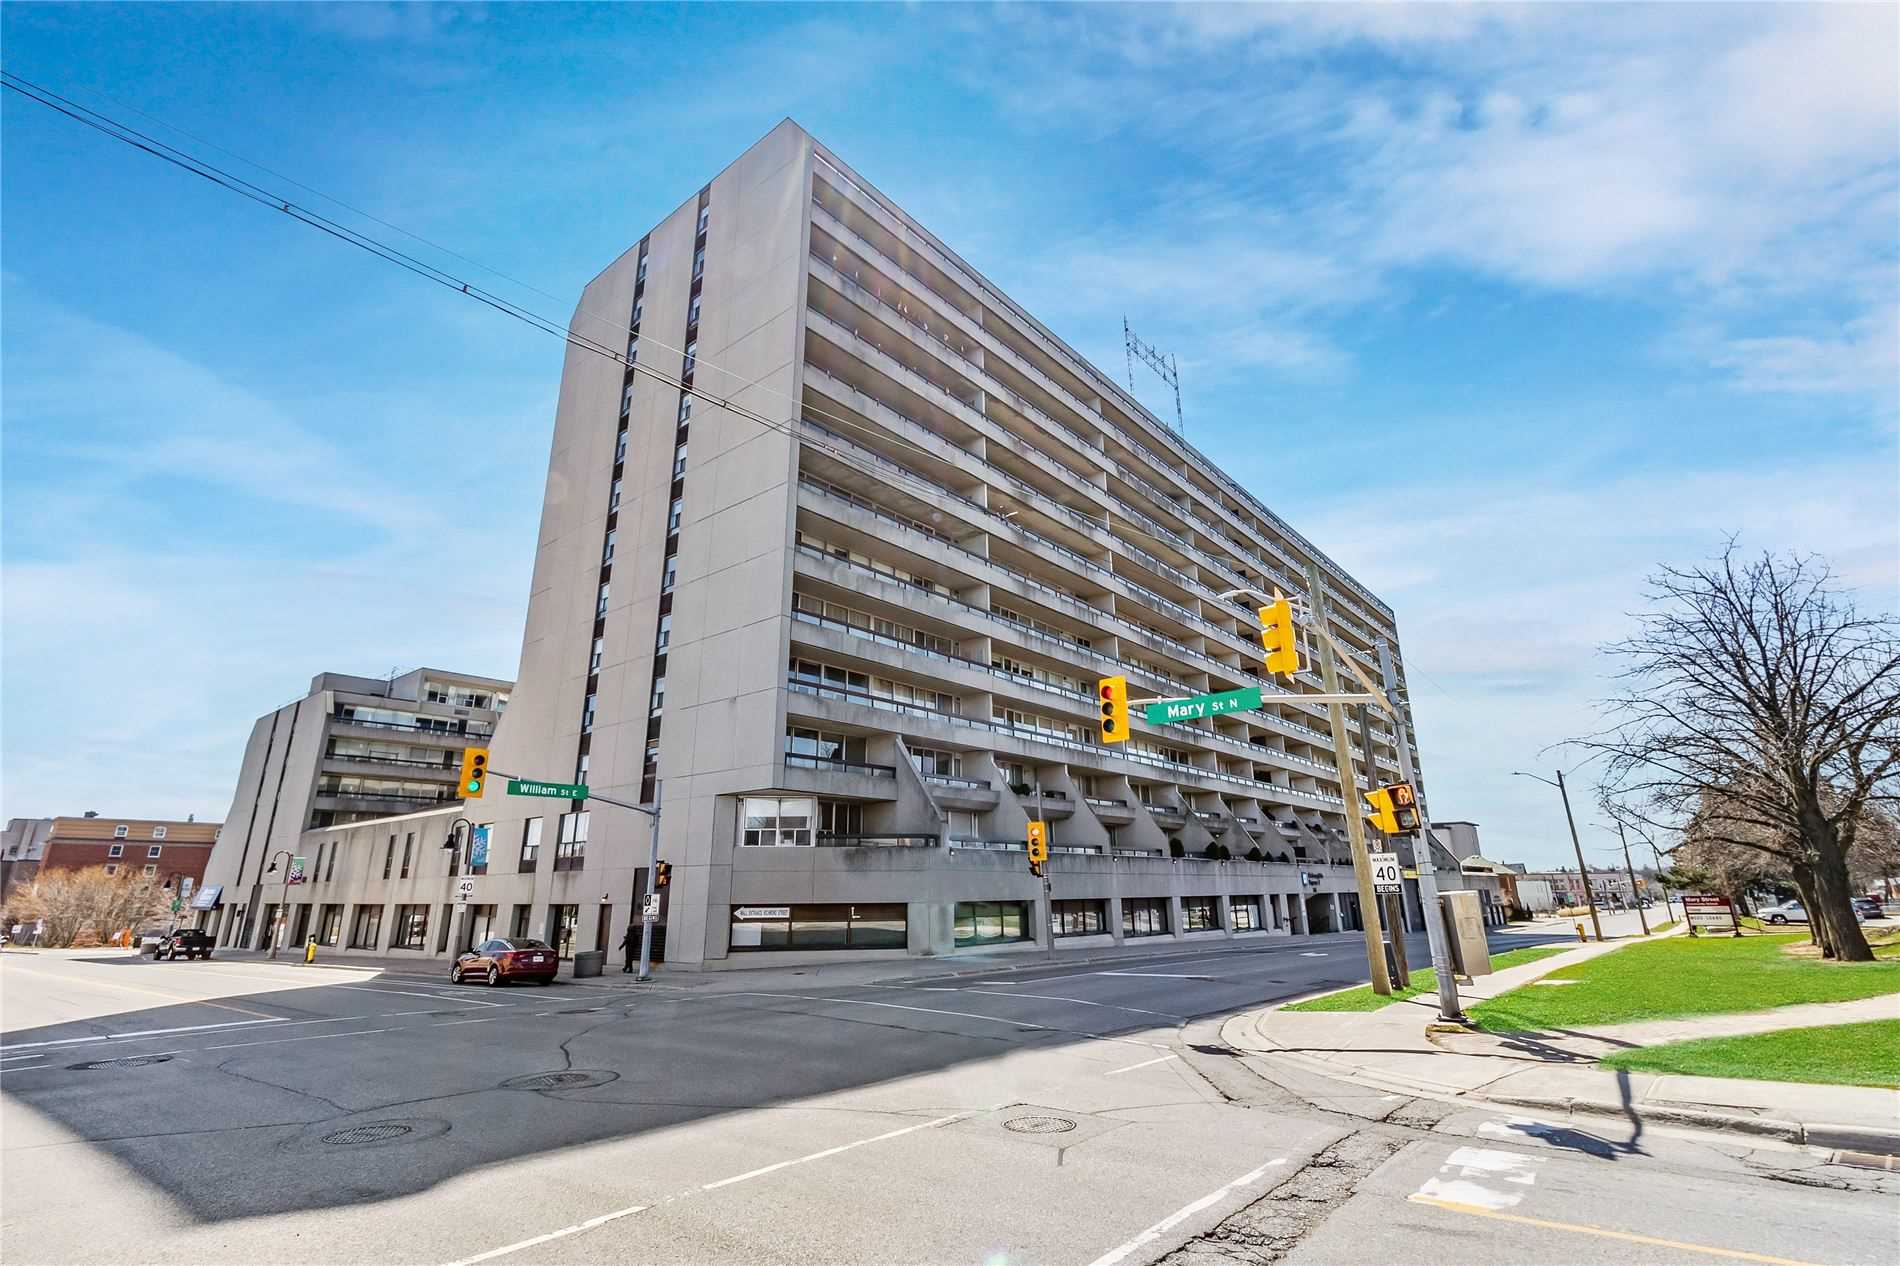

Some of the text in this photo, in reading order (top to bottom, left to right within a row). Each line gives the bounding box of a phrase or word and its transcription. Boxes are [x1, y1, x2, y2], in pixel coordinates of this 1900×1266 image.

[1167, 698, 1238, 718] Mary St N
[520, 783, 557, 795] William
[572, 789, 578, 797] E
[1376, 866, 1396, 881] 40
[460, 882, 473, 892] 40
[1376, 885, 1400, 893] BEGINS
